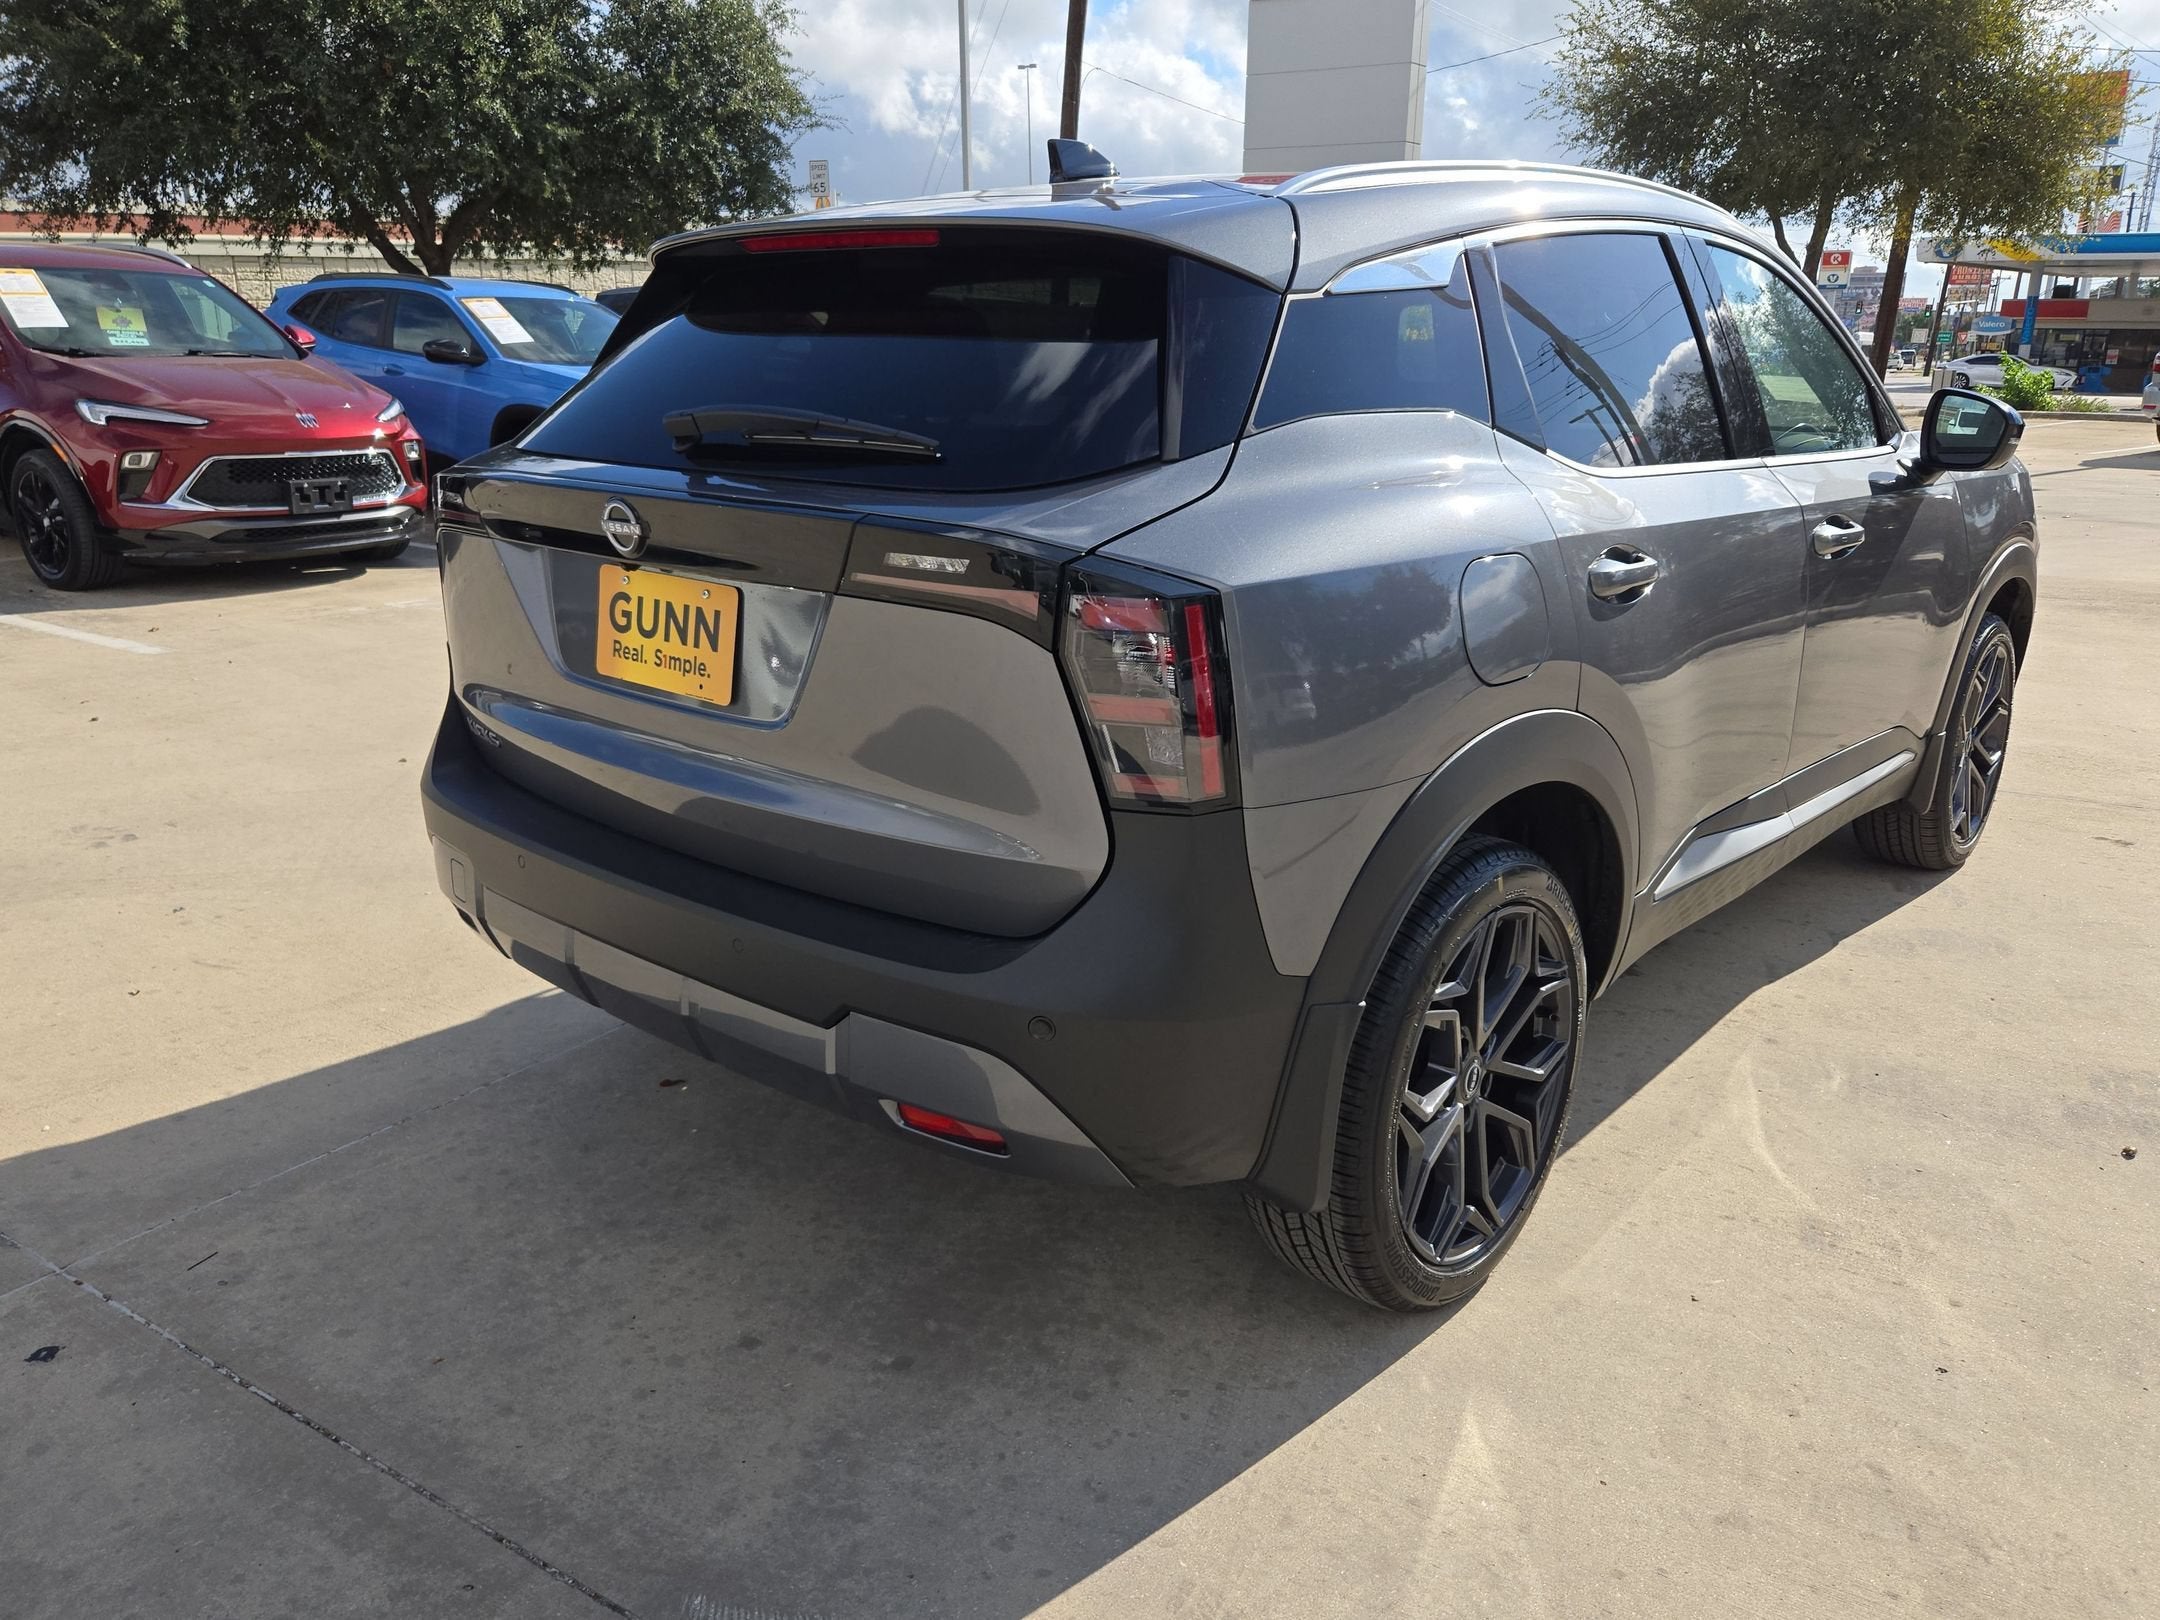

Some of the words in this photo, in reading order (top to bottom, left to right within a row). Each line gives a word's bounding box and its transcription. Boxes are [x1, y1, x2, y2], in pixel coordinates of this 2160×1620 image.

[813, 182, 827, 193] 65
[1979, 320, 2006, 328] Valero
[609, 591, 721, 653] GUNN
[612, 639, 648, 665] Real.
[1383, 1237, 1441, 1302] BRIDGESTONE
